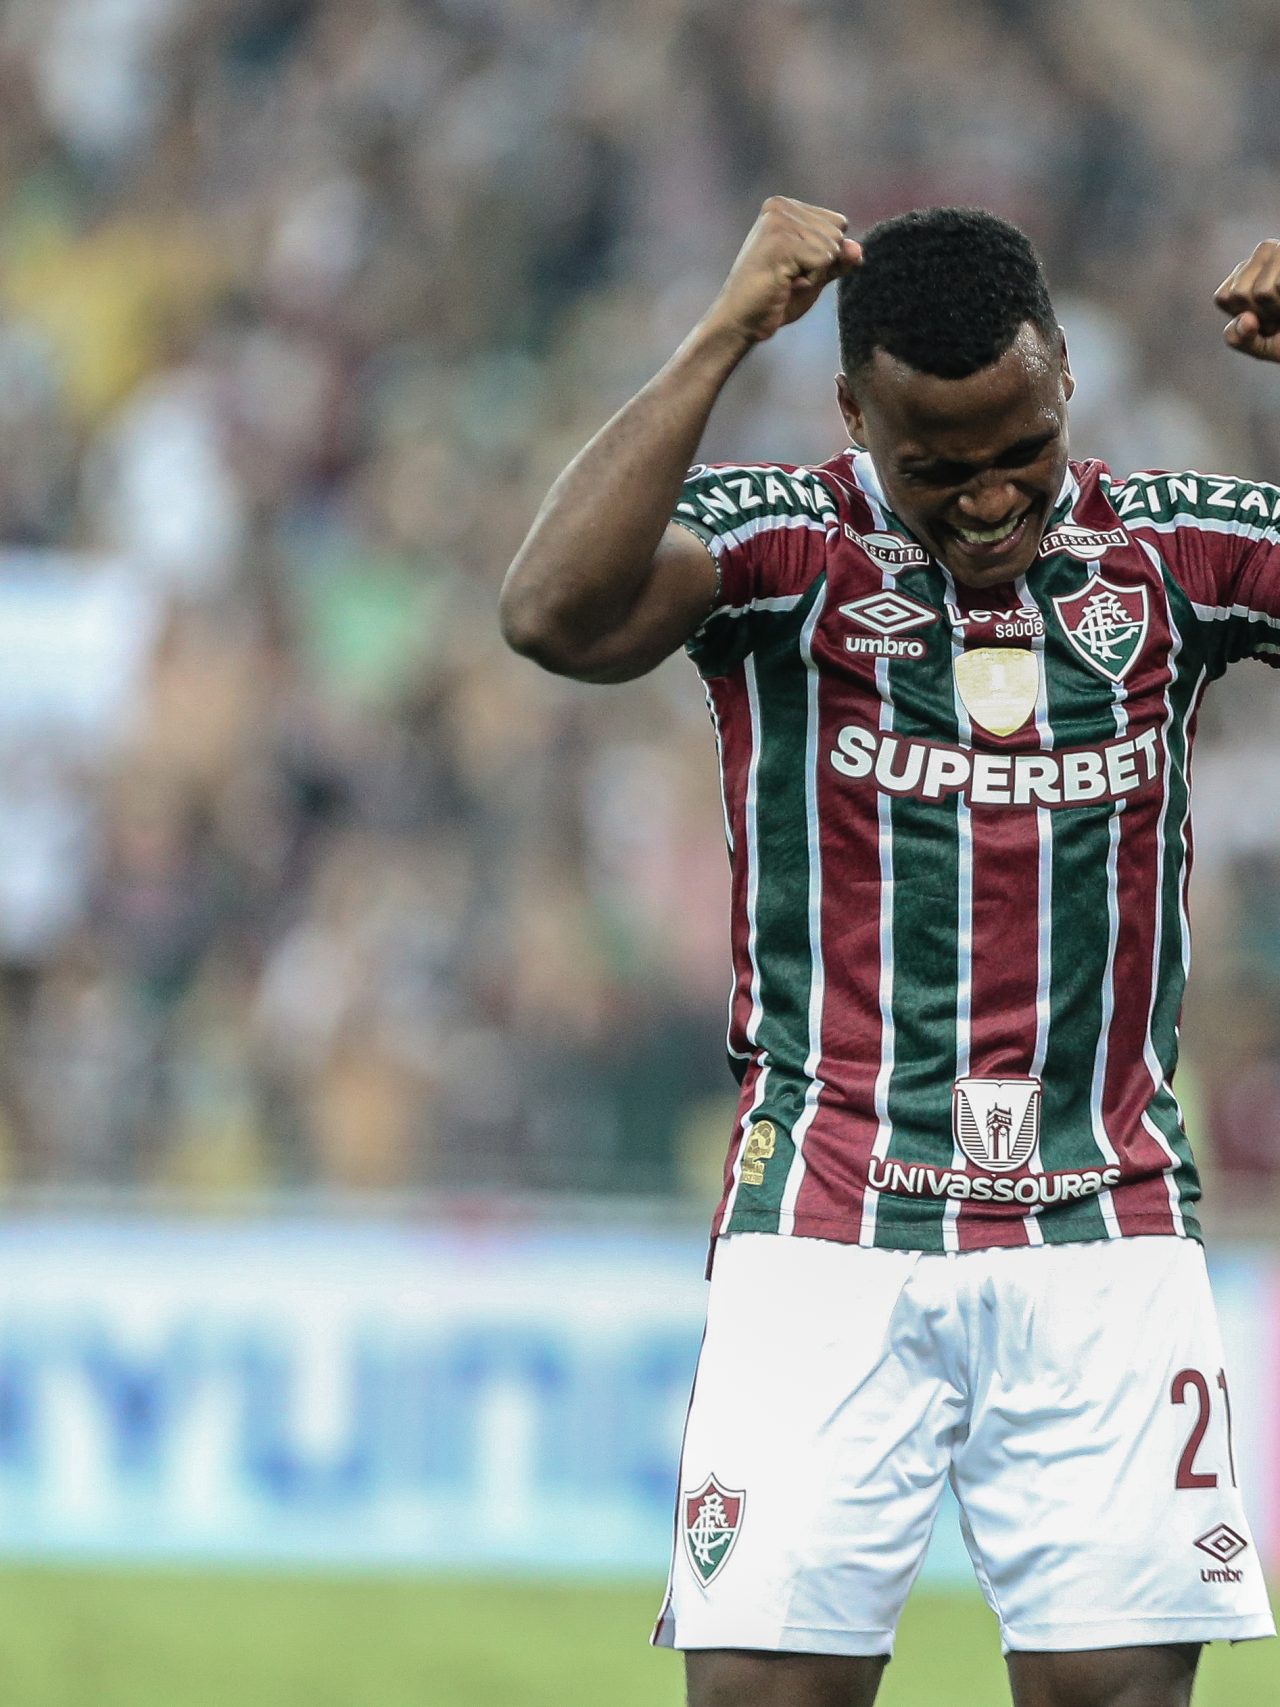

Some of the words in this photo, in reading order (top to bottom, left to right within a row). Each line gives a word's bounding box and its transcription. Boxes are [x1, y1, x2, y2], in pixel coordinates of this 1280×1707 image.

[848, 530, 924, 562] FRESCATTO
[1042, 533, 1121, 551] FRESCATTO
[995, 619, 1044, 638] saúde
[845, 636, 924, 657] umbro
[830, 726, 1157, 803] SUPERBET
[1200, 1564, 1244, 1583] umbr
